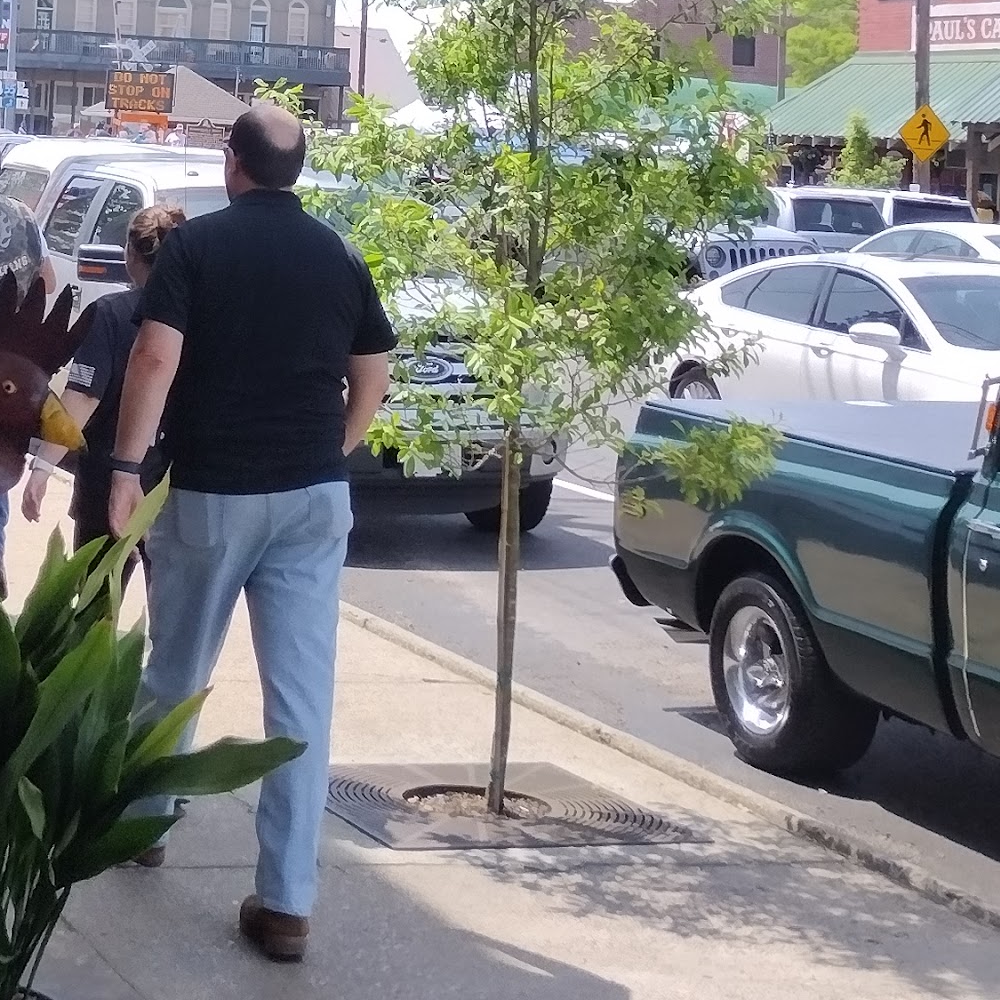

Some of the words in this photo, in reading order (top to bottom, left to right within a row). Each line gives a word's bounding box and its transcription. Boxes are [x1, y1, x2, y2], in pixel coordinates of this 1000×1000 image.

[929, 16, 976, 41] AUL'S
[113, 71, 133, 83] DO
[139, 73, 168, 86] NOT
[108, 83, 145, 97] STOP
[151, 86, 171, 99] ON
[111, 97, 165, 111] TRACKS
